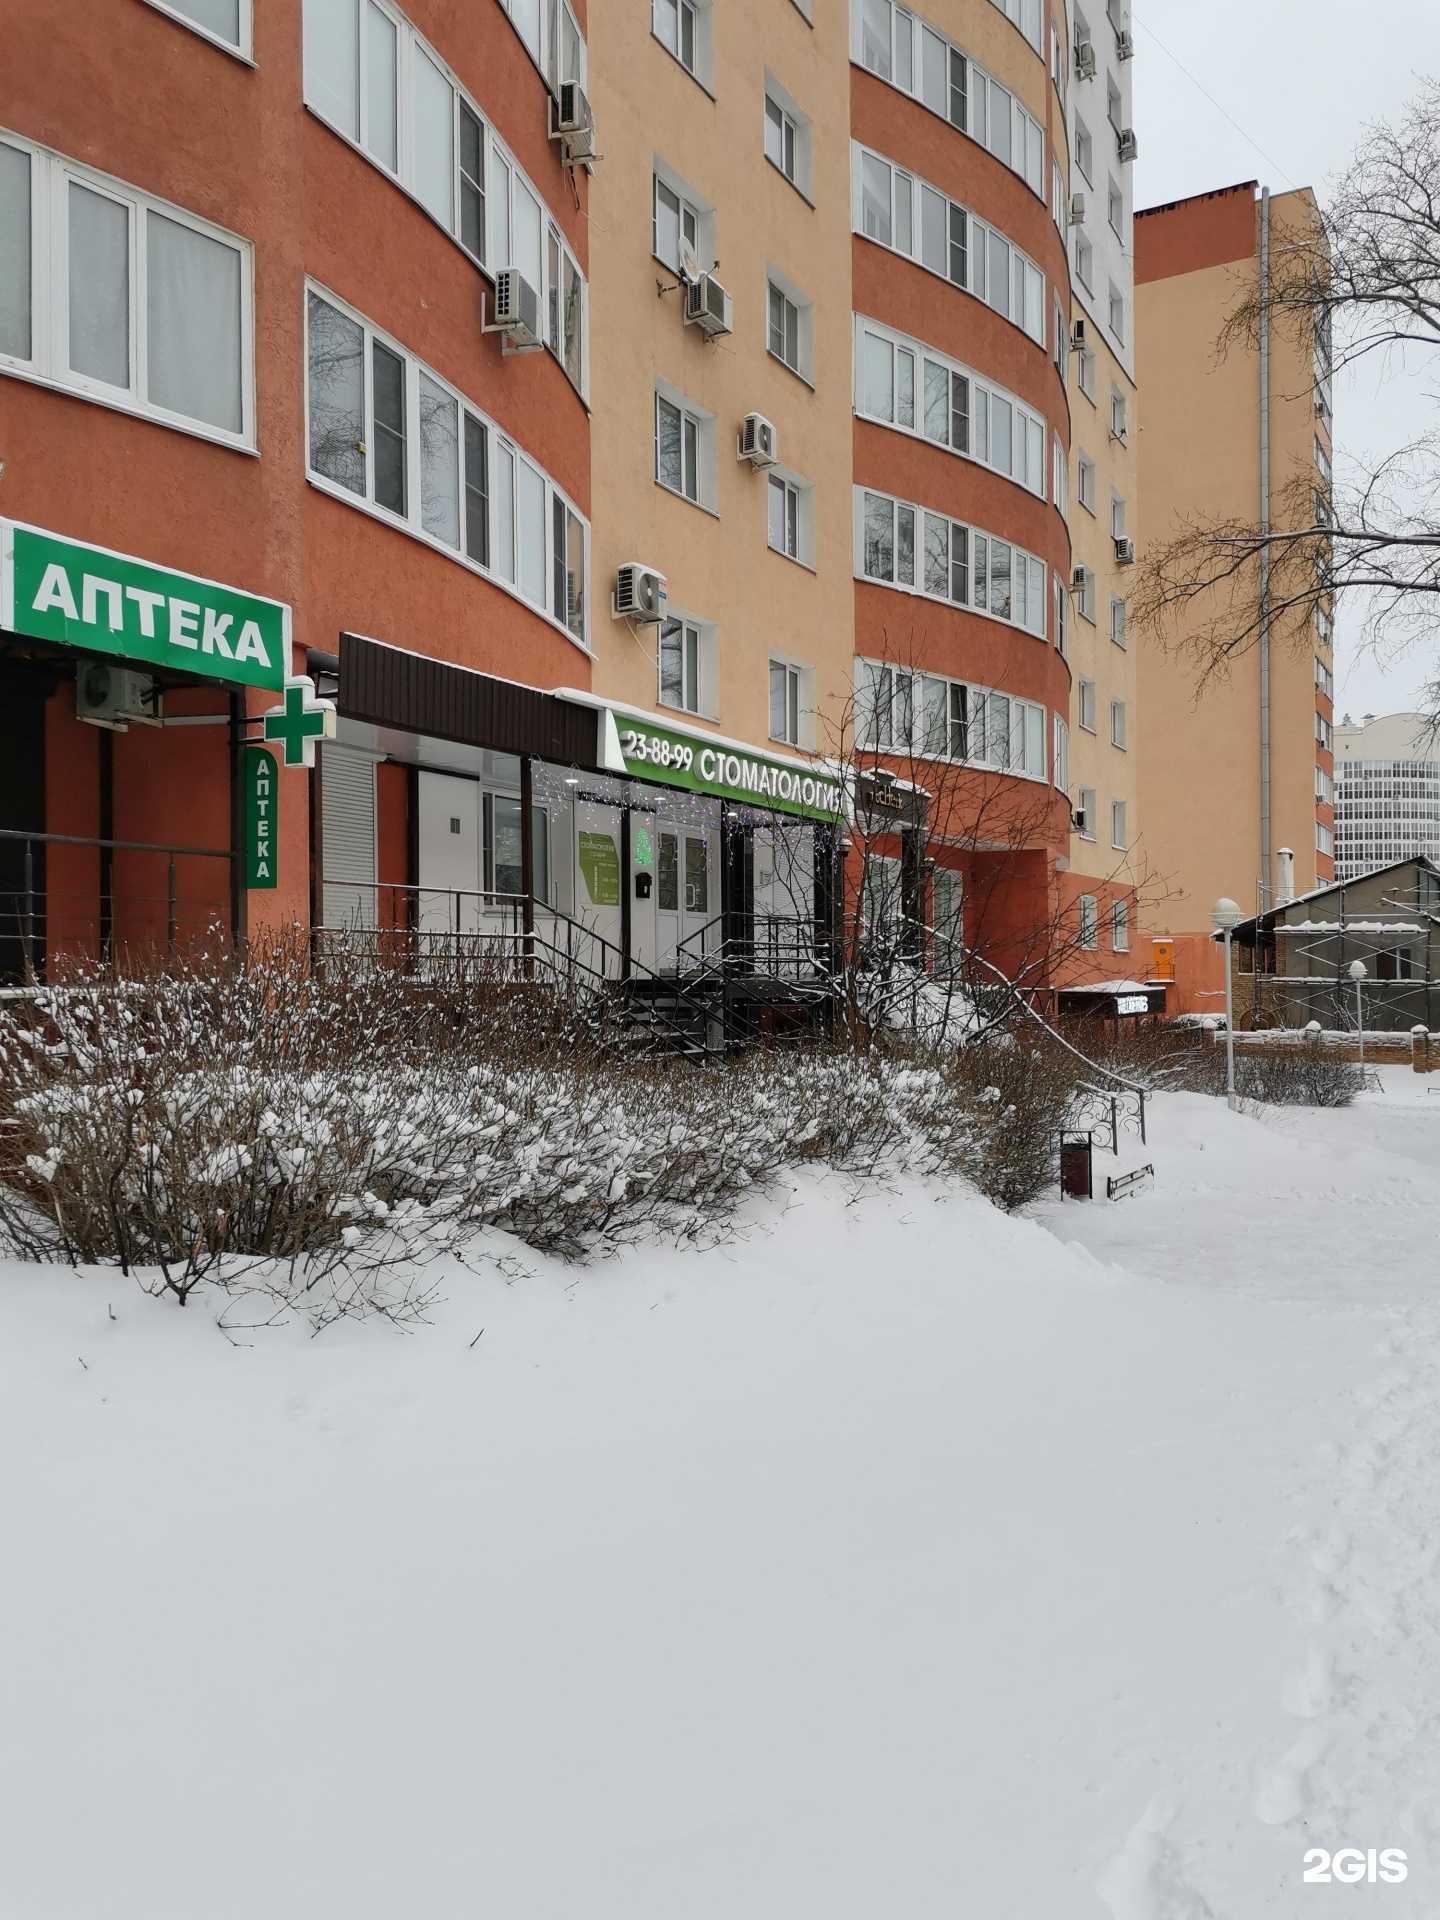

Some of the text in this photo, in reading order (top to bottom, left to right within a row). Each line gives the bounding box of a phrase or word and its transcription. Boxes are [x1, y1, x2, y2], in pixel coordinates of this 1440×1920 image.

[31, 563, 272, 668] АПТЕКА
[624, 730, 694, 772] 23-88-99
[256, 759, 270, 878] АПТЕКА
